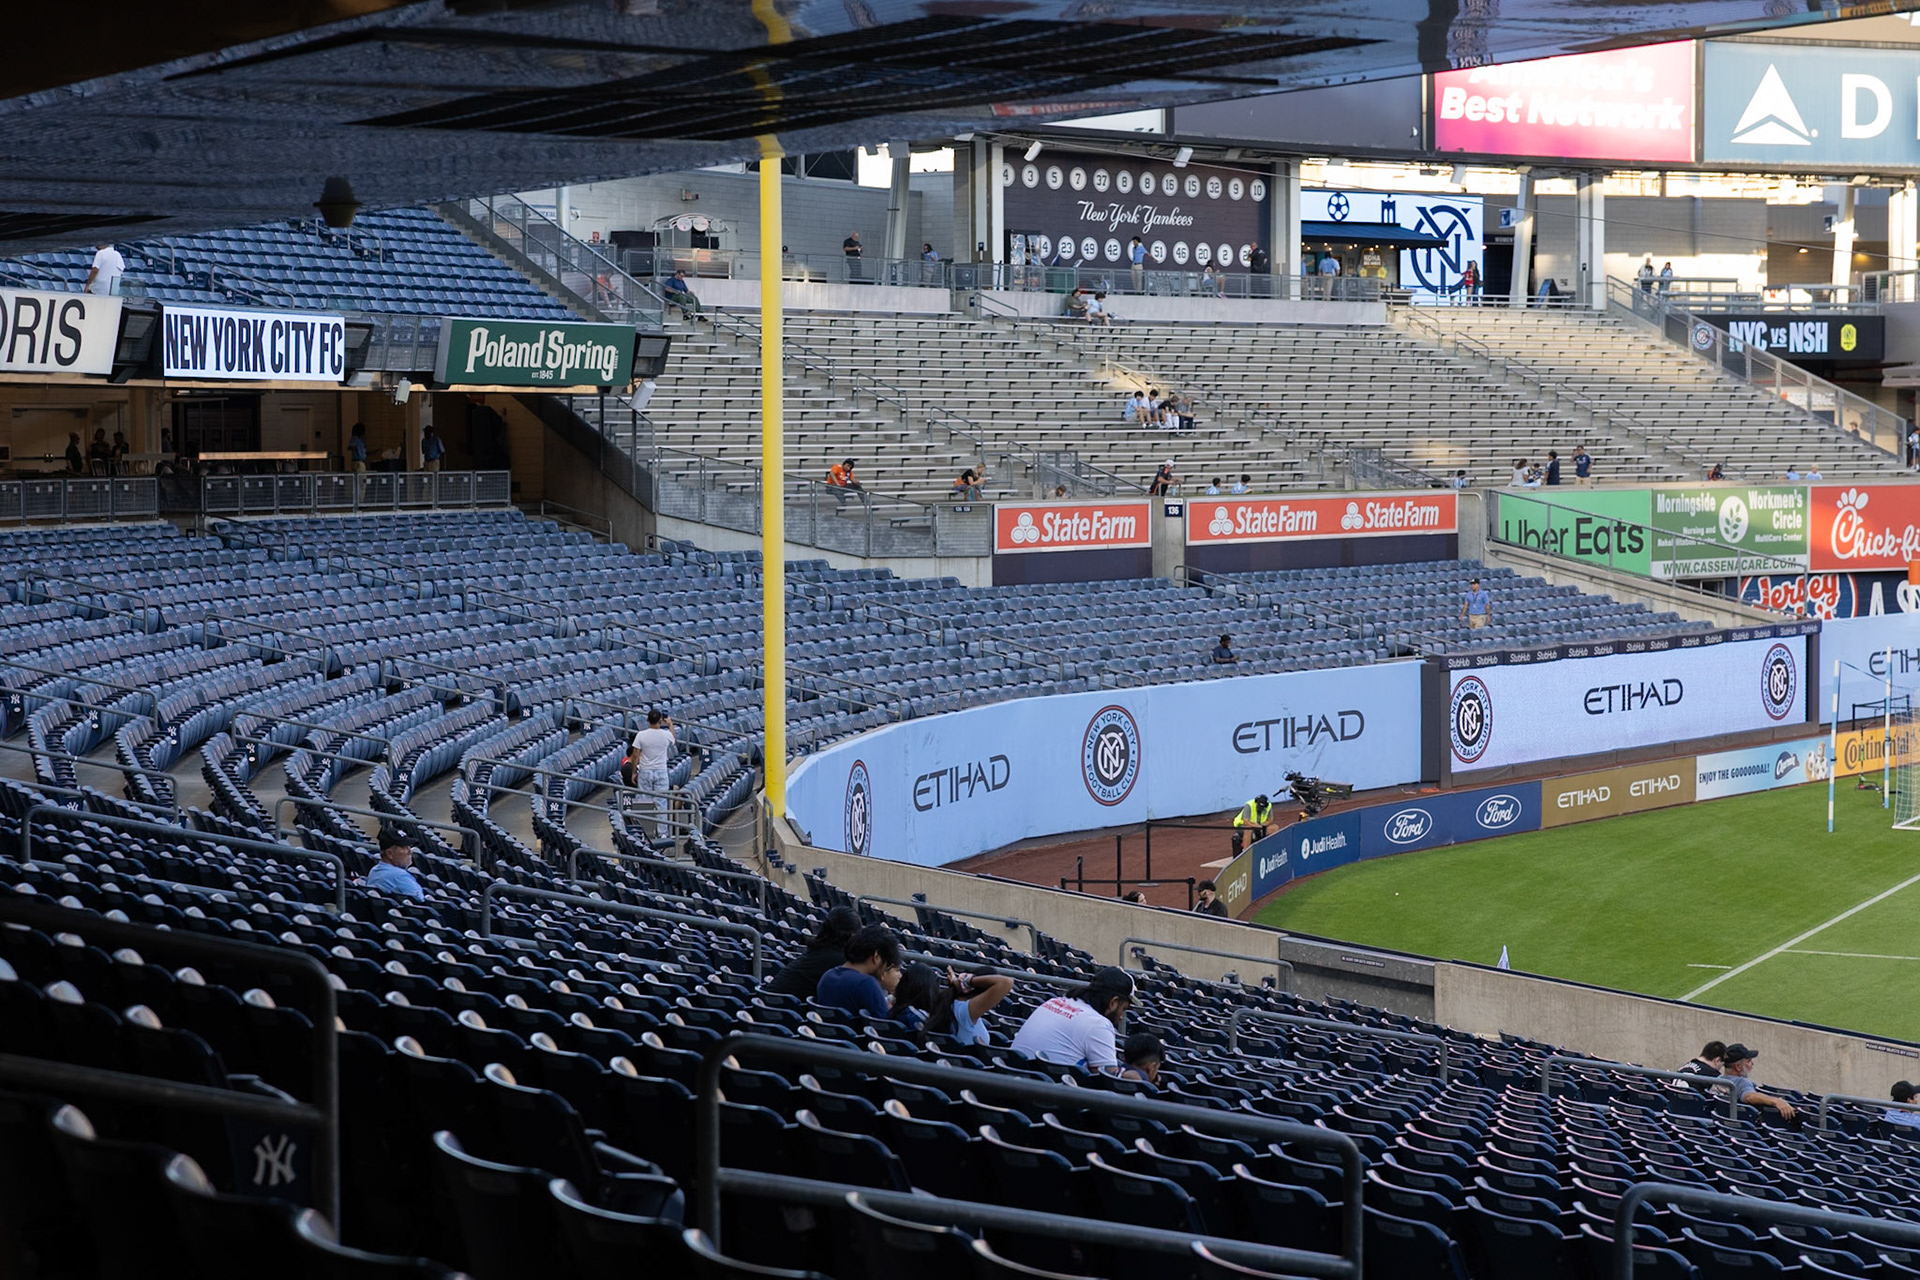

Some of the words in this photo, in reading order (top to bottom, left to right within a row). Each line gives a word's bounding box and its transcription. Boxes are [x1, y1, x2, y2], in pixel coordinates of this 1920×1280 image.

[1442, 88, 1523, 122] Best
[1528, 92, 1685, 129] Network
[1077, 200, 1109, 221] New
[1108, 203, 1141, 232] York
[1142, 205, 1194, 233] Yankees
[166, 313, 209, 370] NEW
[211, 316, 266, 372] YORK
[270, 320, 316, 374] CITY
[319, 323, 343, 375] FC
[464, 327, 546, 373] Poland
[545, 330, 618, 381] Spring
[1729, 321, 1768, 353] NYC
[1770, 328, 1787, 344] vs
[1789, 321, 1829, 353] NSH
[539, 370, 553, 379] 1845
[1168, 506, 1180, 515] 136
[1657, 492, 1716, 517] Morningside
[1748, 489, 1802, 510] Workmen's
[1505, 519, 1568, 554] Uber
[1575, 517, 1644, 555] Eats
[1772, 510, 1802, 529] Circle
[1448, 659, 1470, 668] StubHub
[1476, 656, 1498, 666] StubHub
[1510, 653, 1531, 663] StubHub
[1536, 650, 1557, 660] StubHub
[1568, 648, 1588, 658] StubHub
[1594, 645, 1613, 656] StubHub
[1626, 642, 1646, 652] StubHub
[1650, 640, 1669, 650] StubHub
[1681, 637, 1700, 647] StubHub
[1704, 634, 1722, 644] StubHub
[1732, 632, 1749, 641] StubHub
[1754, 630, 1770, 640] StubHub
[1780, 627, 1796, 636] StubHub
[1800, 624, 1818, 634] StubHub
[1451, 690, 1461, 714] NEW
[1461, 682, 1479, 693] YORK
[1479, 689, 1489, 710] CITY
[1584, 678, 1683, 715] ETIHAD
[1086, 721, 1101, 749] NEW
[1100, 712, 1124, 724] YORK
[1123, 720, 1136, 745] CITY
[1232, 709, 1365, 754] ETIHAD
[1477, 723, 1489, 749] CLUB
[913, 754, 1010, 812] ETIHAD
[1086, 764, 1121, 799] FOOTBALL
[1121, 760, 1136, 790] CLUB
[1557, 786, 1611, 808] ETIHAD
[1630, 774, 1681, 797] ETIHAD
[1699, 770, 1717, 785] ENJOY
[1718, 769, 1729, 780] THE
[1393, 814, 1425, 840] Ford
[1484, 799, 1514, 824] Ford
[253, 1133, 297, 1186] NY
